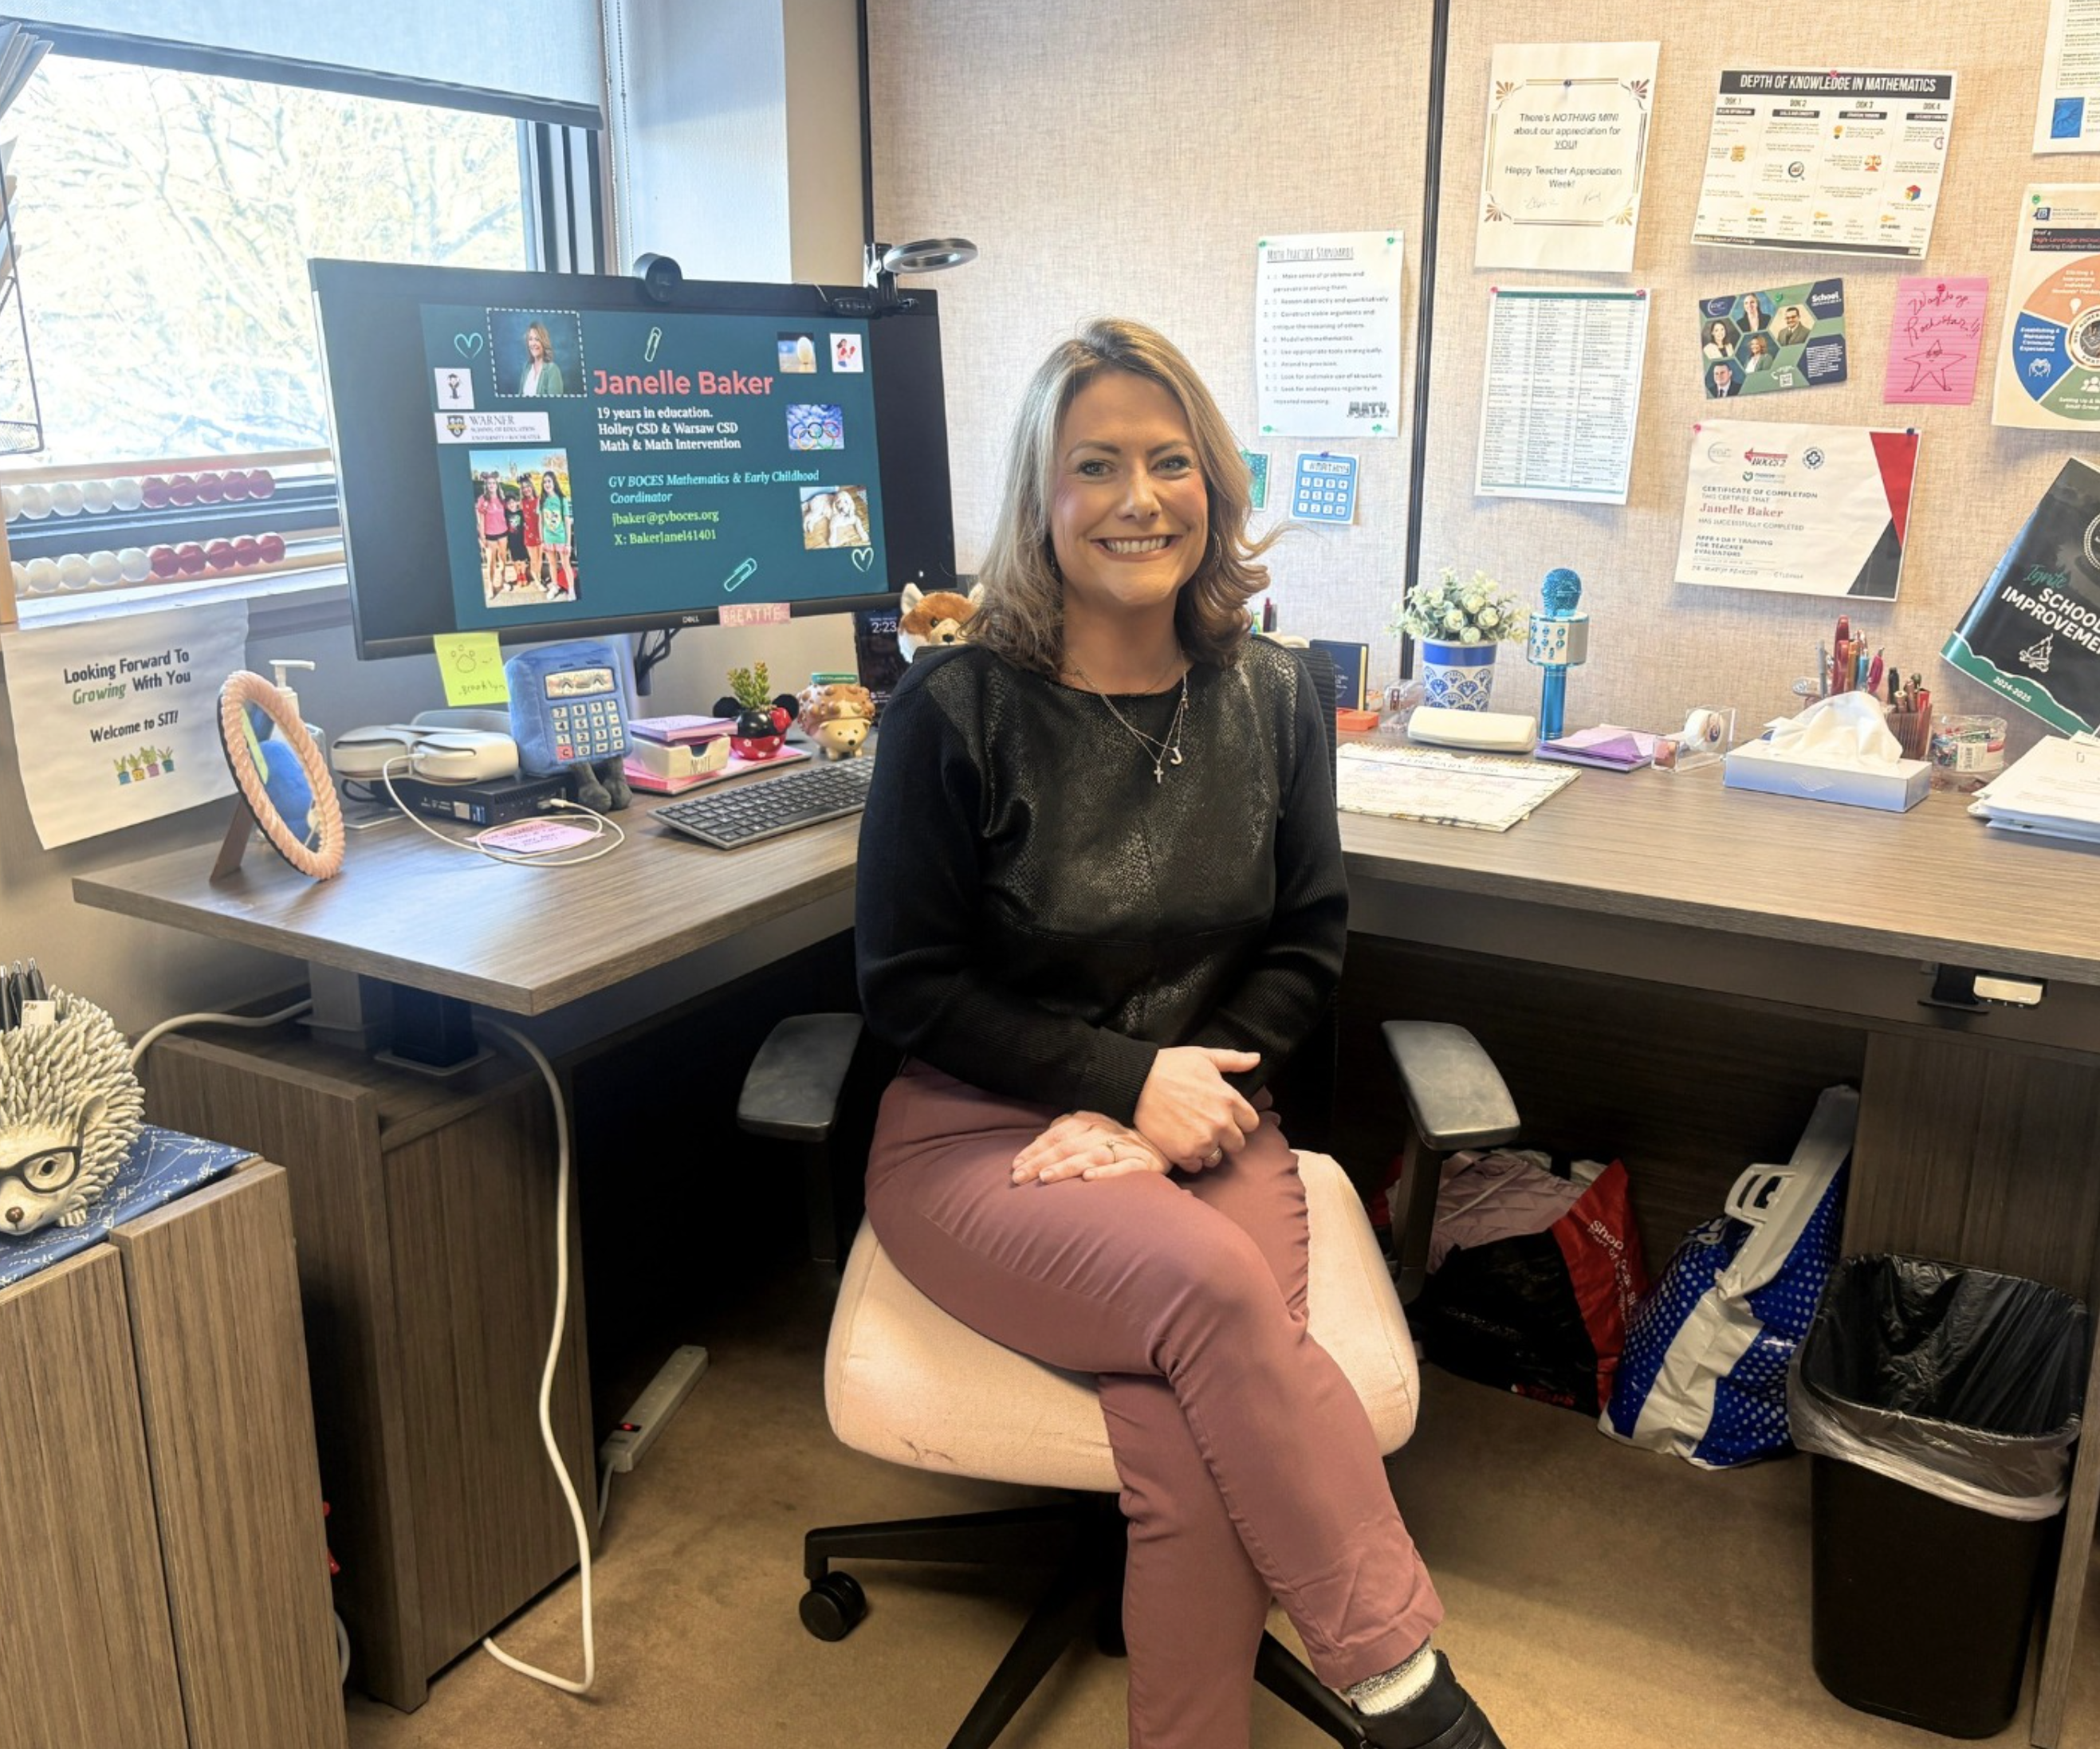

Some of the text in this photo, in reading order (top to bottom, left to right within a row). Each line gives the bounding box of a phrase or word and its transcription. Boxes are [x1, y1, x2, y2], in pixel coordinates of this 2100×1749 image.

[1740, 74, 1937, 92] DEPTH OF KNOWLEDGE IN MATHEMATICS
[1520, 112, 1619, 122] There's NOTHING MINI
[1514, 127, 1539, 136] about
[1555, 126, 1607, 137] appreciation
[1609, 126, 1621, 136] for
[1505, 166, 1622, 177] Happy Teacher Appreciation
[1549, 179, 1575, 188] Week!
[1812, 291, 1838, 303] School
[594, 369, 773, 395] Janelle Baker
[469, 415, 515, 426] WARNER
[598, 407, 713, 422] 19 years in education.
[598, 423, 738, 437] Holley CSD & Warsaw CSD
[600, 438, 741, 452] Math & Math Intervention
[608, 470, 819, 488] GV BOCES Mathematics & Early Childhood
[610, 491, 672, 505] Coordinator
[1702, 485, 1752, 495] CERTIFICATE
[1766, 489, 1818, 499] COMPLETION
[1699, 502, 1784, 518] Janelle Baker
[612, 510, 719, 527] jbaker@gvboces.org
[614, 533, 627, 546] X:
[2023, 564, 2067, 589] Ignite
[723, 606, 781, 624] BREATHE
[2038, 588, 2100, 634] SCHOOL
[682, 614, 700, 624] DELL
[2000, 586, 2100, 654] IMPROVEME
[871, 620, 898, 634] 2:23
[63, 648, 190, 685] Looking Forward To
[72, 670, 191, 705] Growing With You
[1993, 676, 2032, 703] 2024-2025
[90, 709, 179, 743] Welcome to SIT!
[1589, 1220, 1624, 1251] Shop
